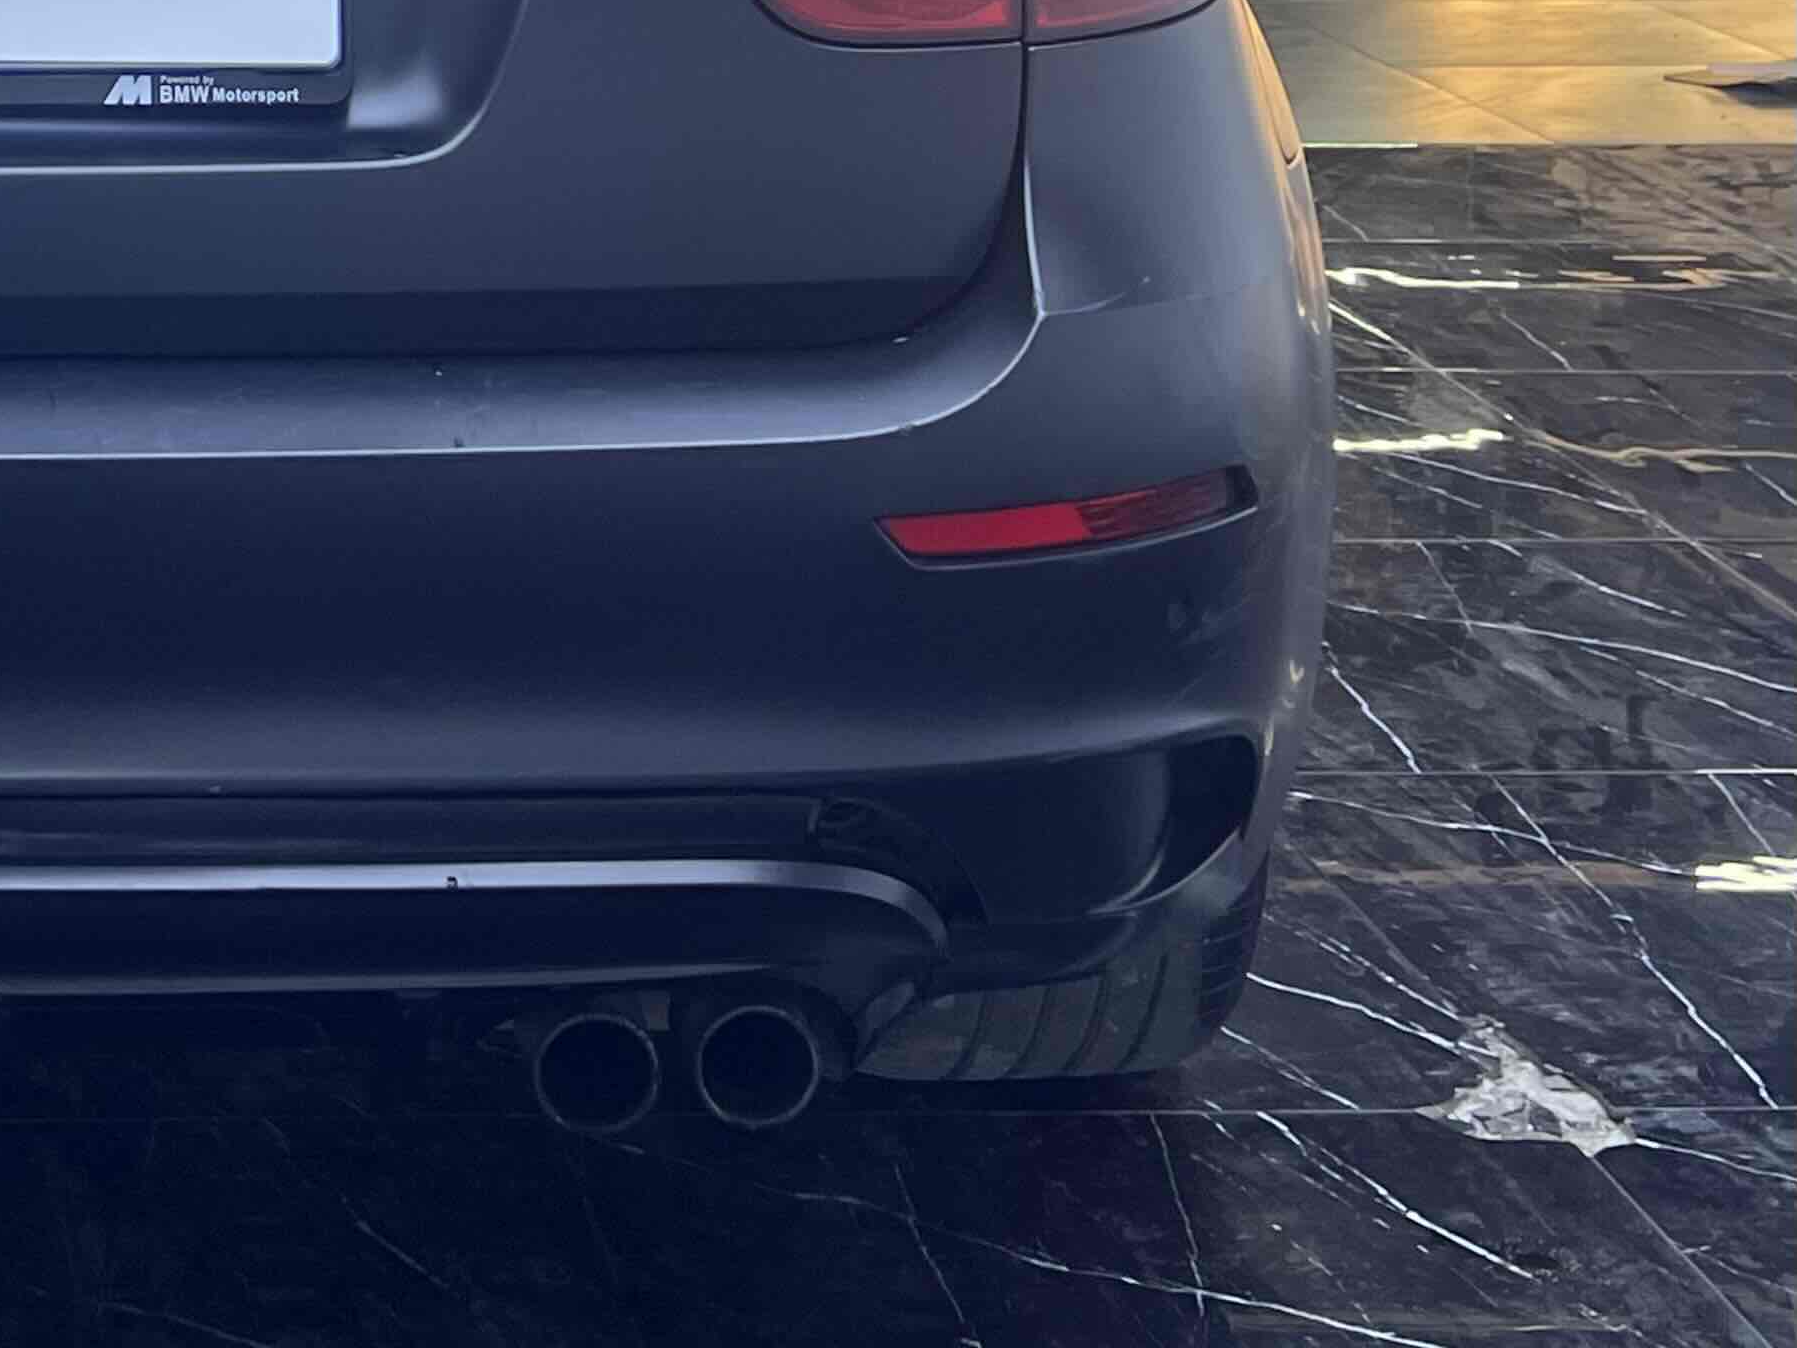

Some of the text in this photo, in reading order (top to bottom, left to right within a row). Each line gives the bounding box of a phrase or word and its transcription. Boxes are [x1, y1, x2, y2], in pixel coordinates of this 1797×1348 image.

[103, 74, 153, 106] M
[159, 84, 300, 105] BMW Motorsport
